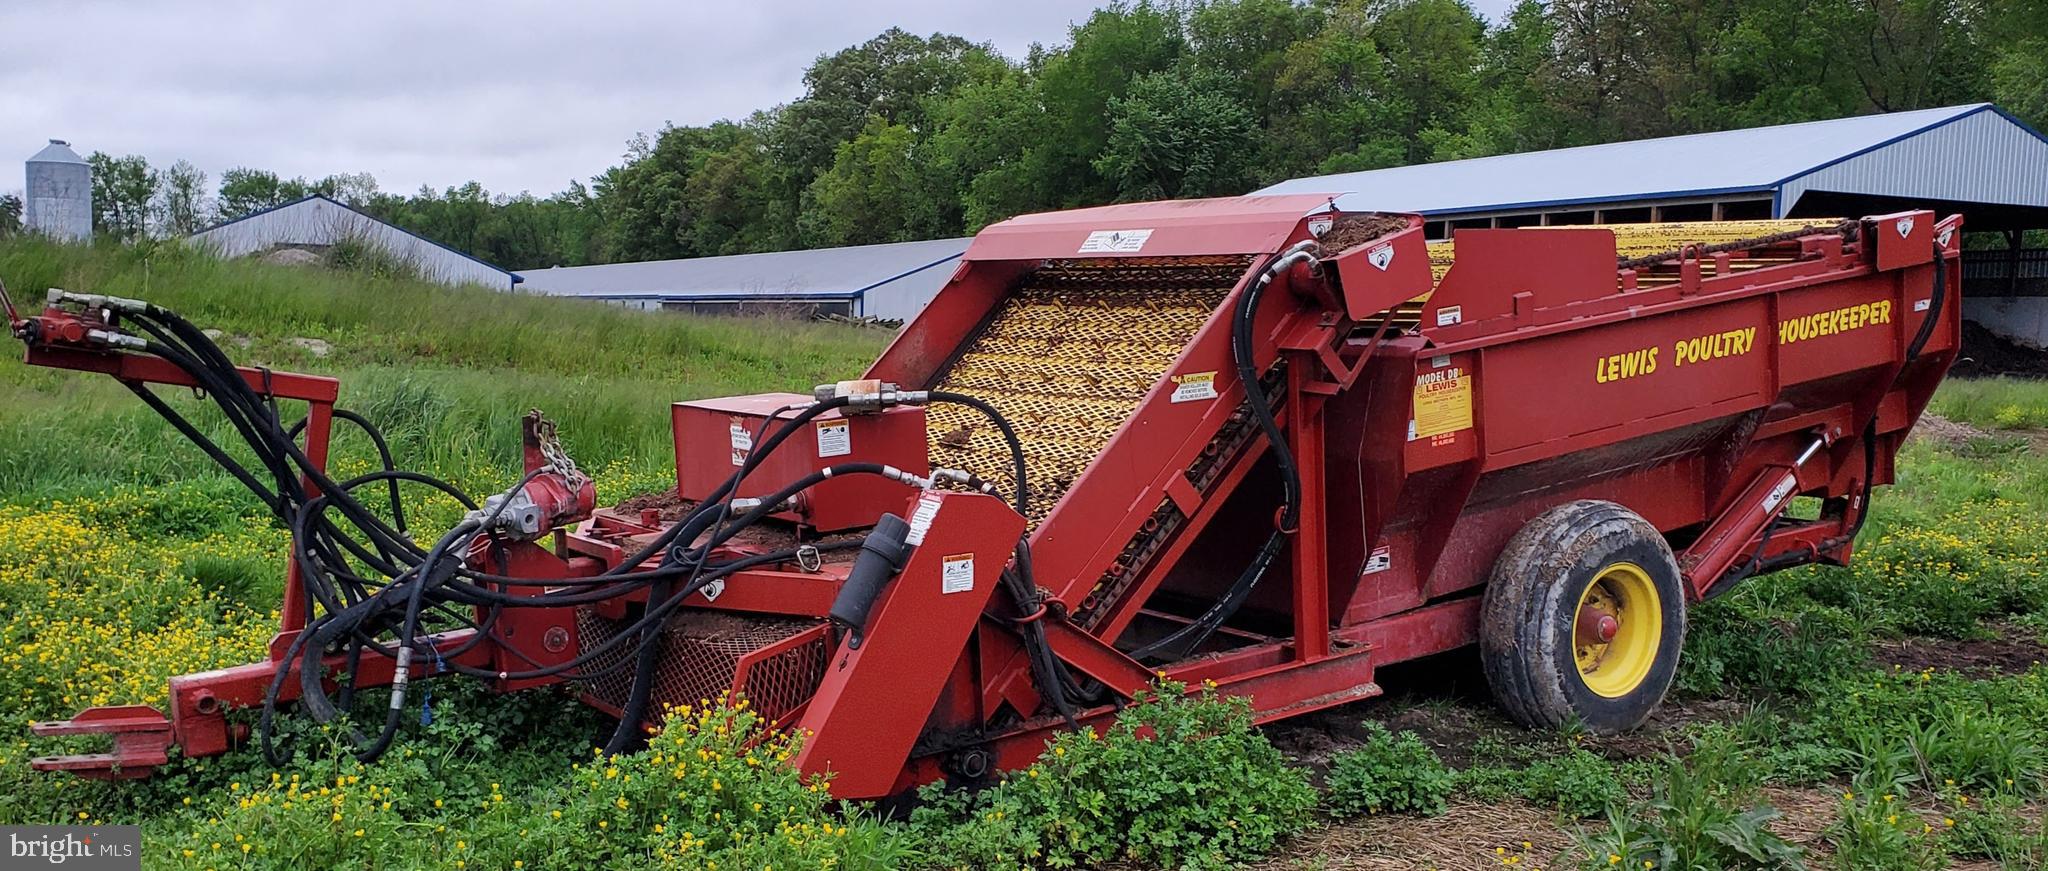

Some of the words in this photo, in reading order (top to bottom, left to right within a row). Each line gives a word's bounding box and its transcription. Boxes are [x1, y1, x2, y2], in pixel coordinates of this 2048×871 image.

[1596, 347, 1659, 383] LEWIS
[1674, 327, 1756, 366] POULTRY
[1778, 300, 1891, 345] HOUSEKEEPER
[1416, 370, 1445, 386] MODEL
[1426, 380, 1458, 393] LEWIS
